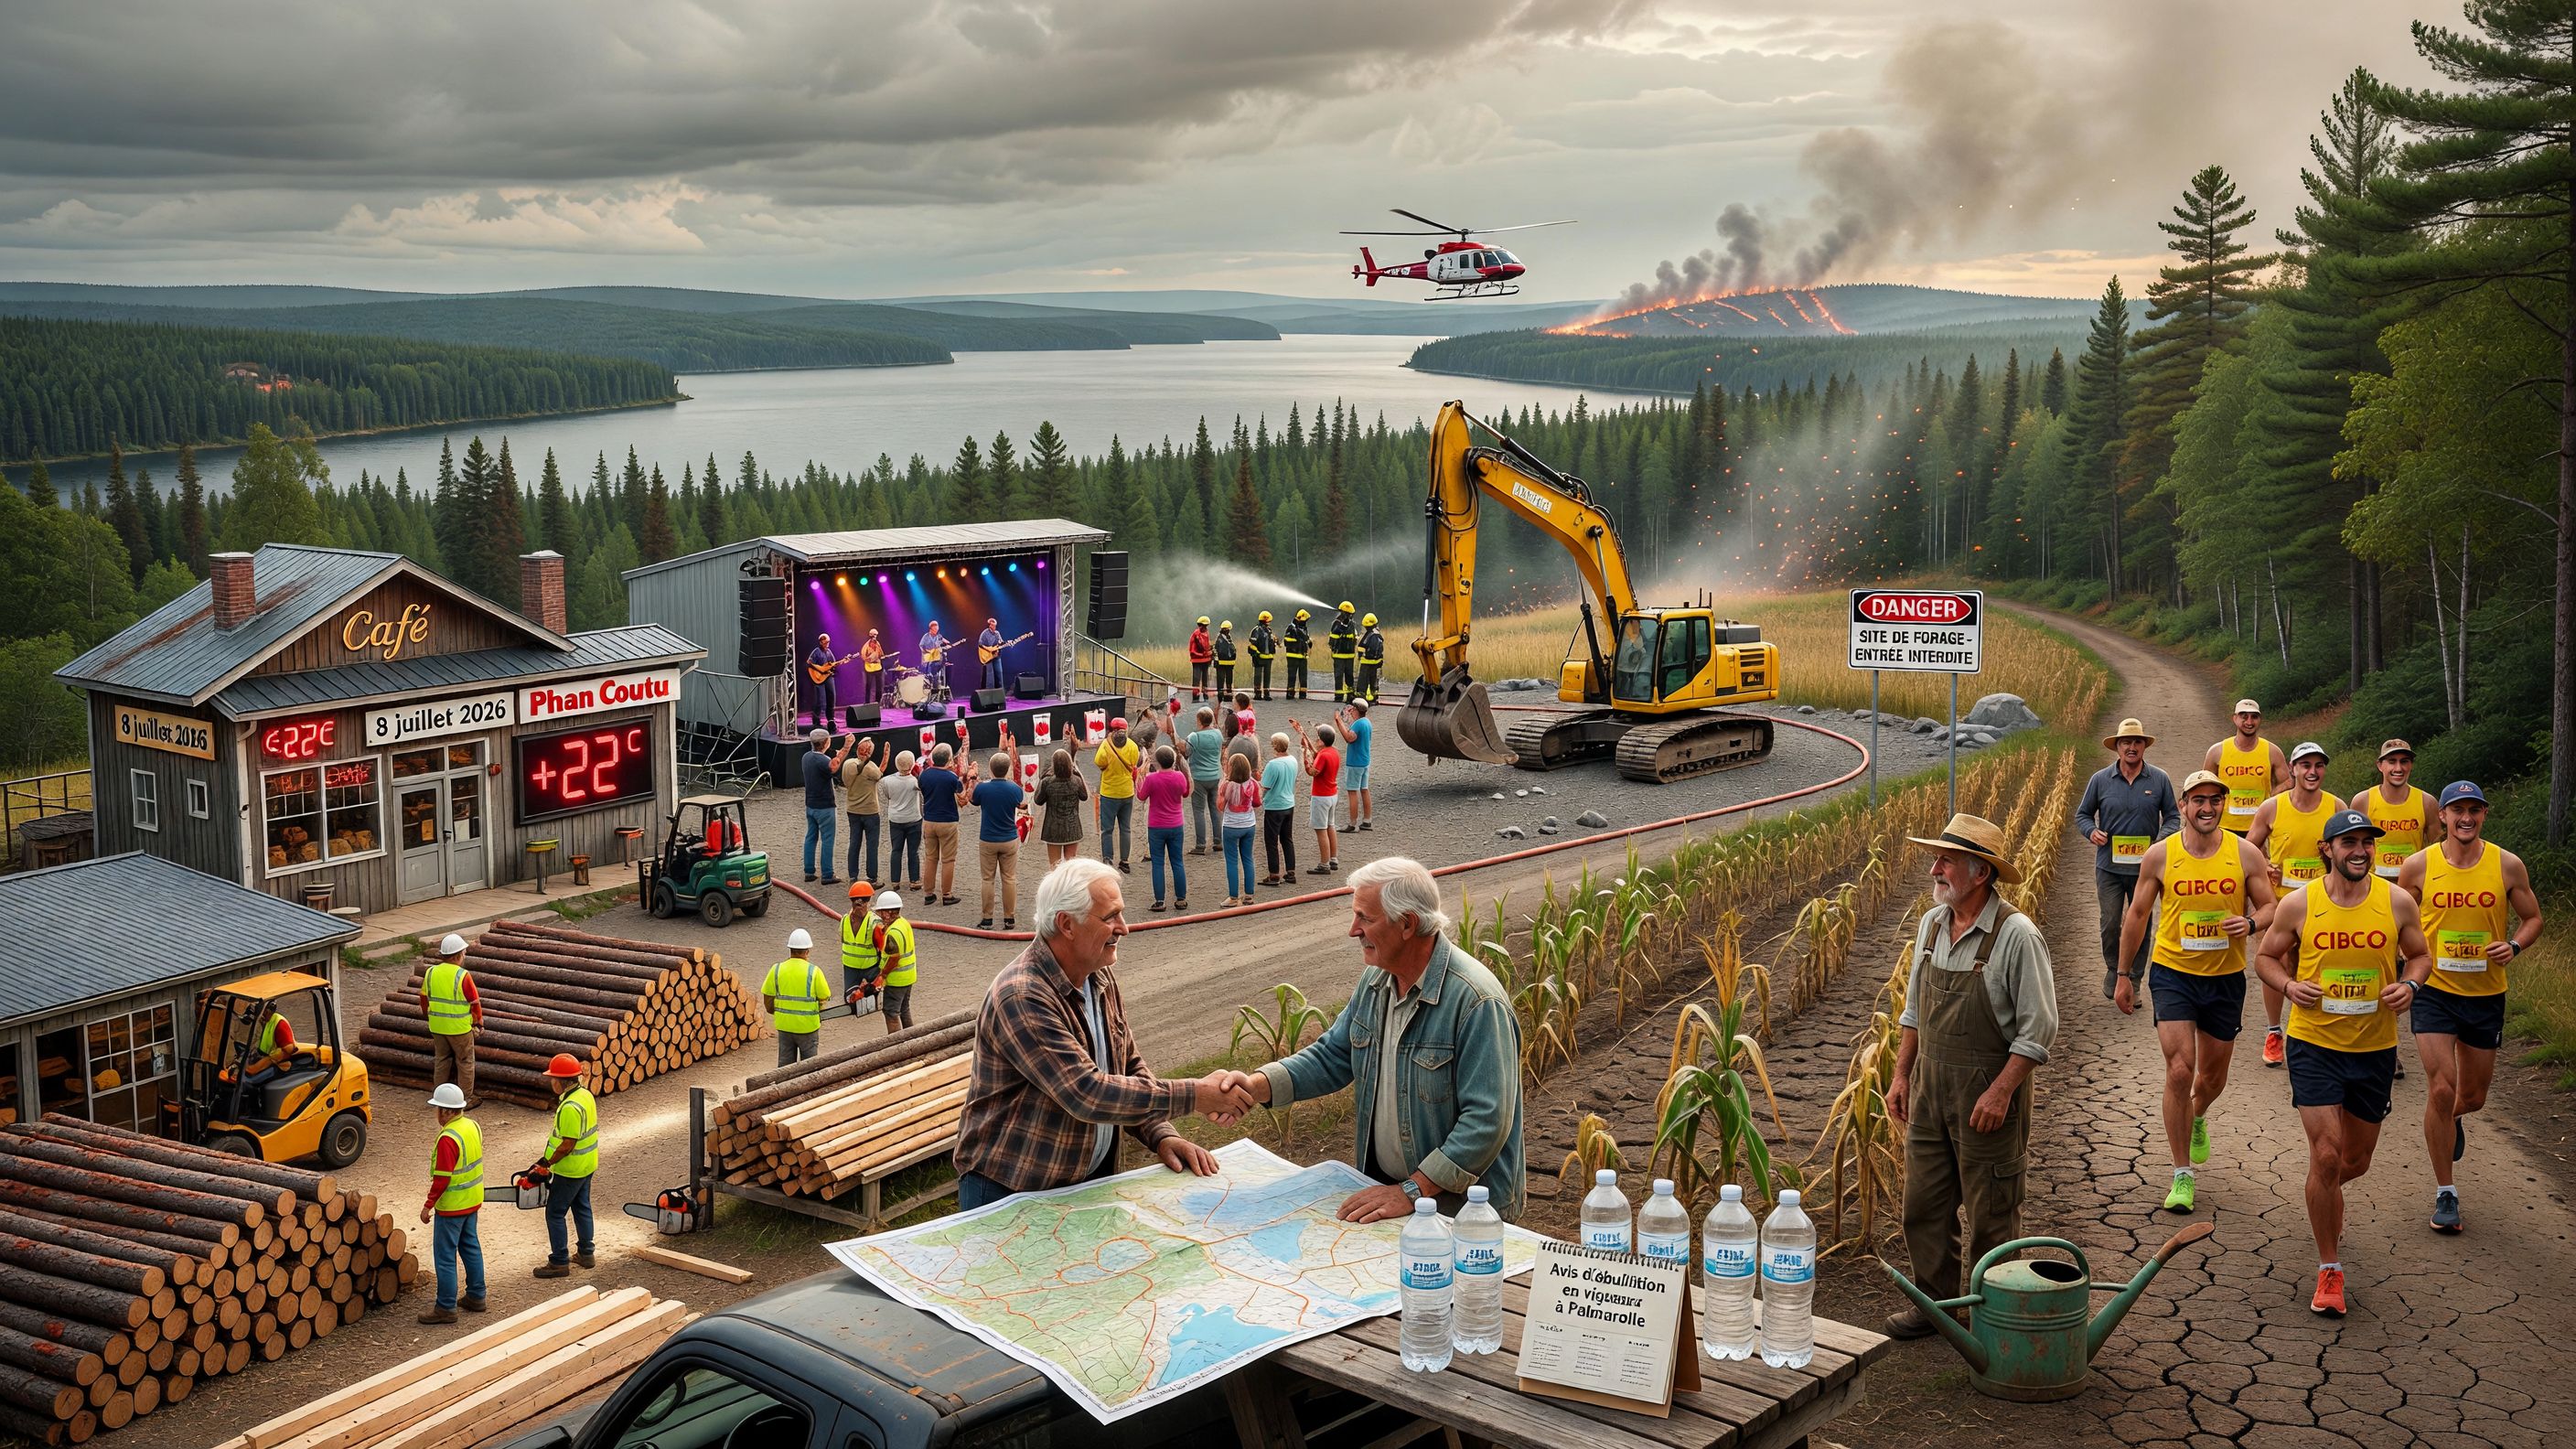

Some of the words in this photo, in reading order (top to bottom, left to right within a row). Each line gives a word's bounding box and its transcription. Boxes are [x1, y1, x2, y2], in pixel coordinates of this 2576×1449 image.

[1872, 598, 1958, 618] DANGER
[343, 604, 431, 659] Café
[1859, 629, 1887, 643] SITE
[1893, 631, 1909, 644] DE
[1914, 631, 1965, 645] FORAGE
[1855, 647, 1903, 661] ENTRÉE
[1908, 649, 1973, 664] INTERDITE
[530, 688, 594, 716] Phan
[599, 677, 670, 704] Coutu
[121, 714, 131, 735] 8
[376, 716, 389, 736] 8
[394, 708, 453, 739] juillet
[459, 699, 506, 724] 2026
[2174, 877, 2237, 896] CIBCO
[2431, 891, 2496, 908] CIBCO
[2313, 929, 2388, 950] CIBCO
[1550, 1262, 1578, 1279] Avis
[1562, 1285, 1579, 1297] en
[1555, 1300, 1563, 1314] à
[1568, 1301, 1646, 1327] Palmarolle
